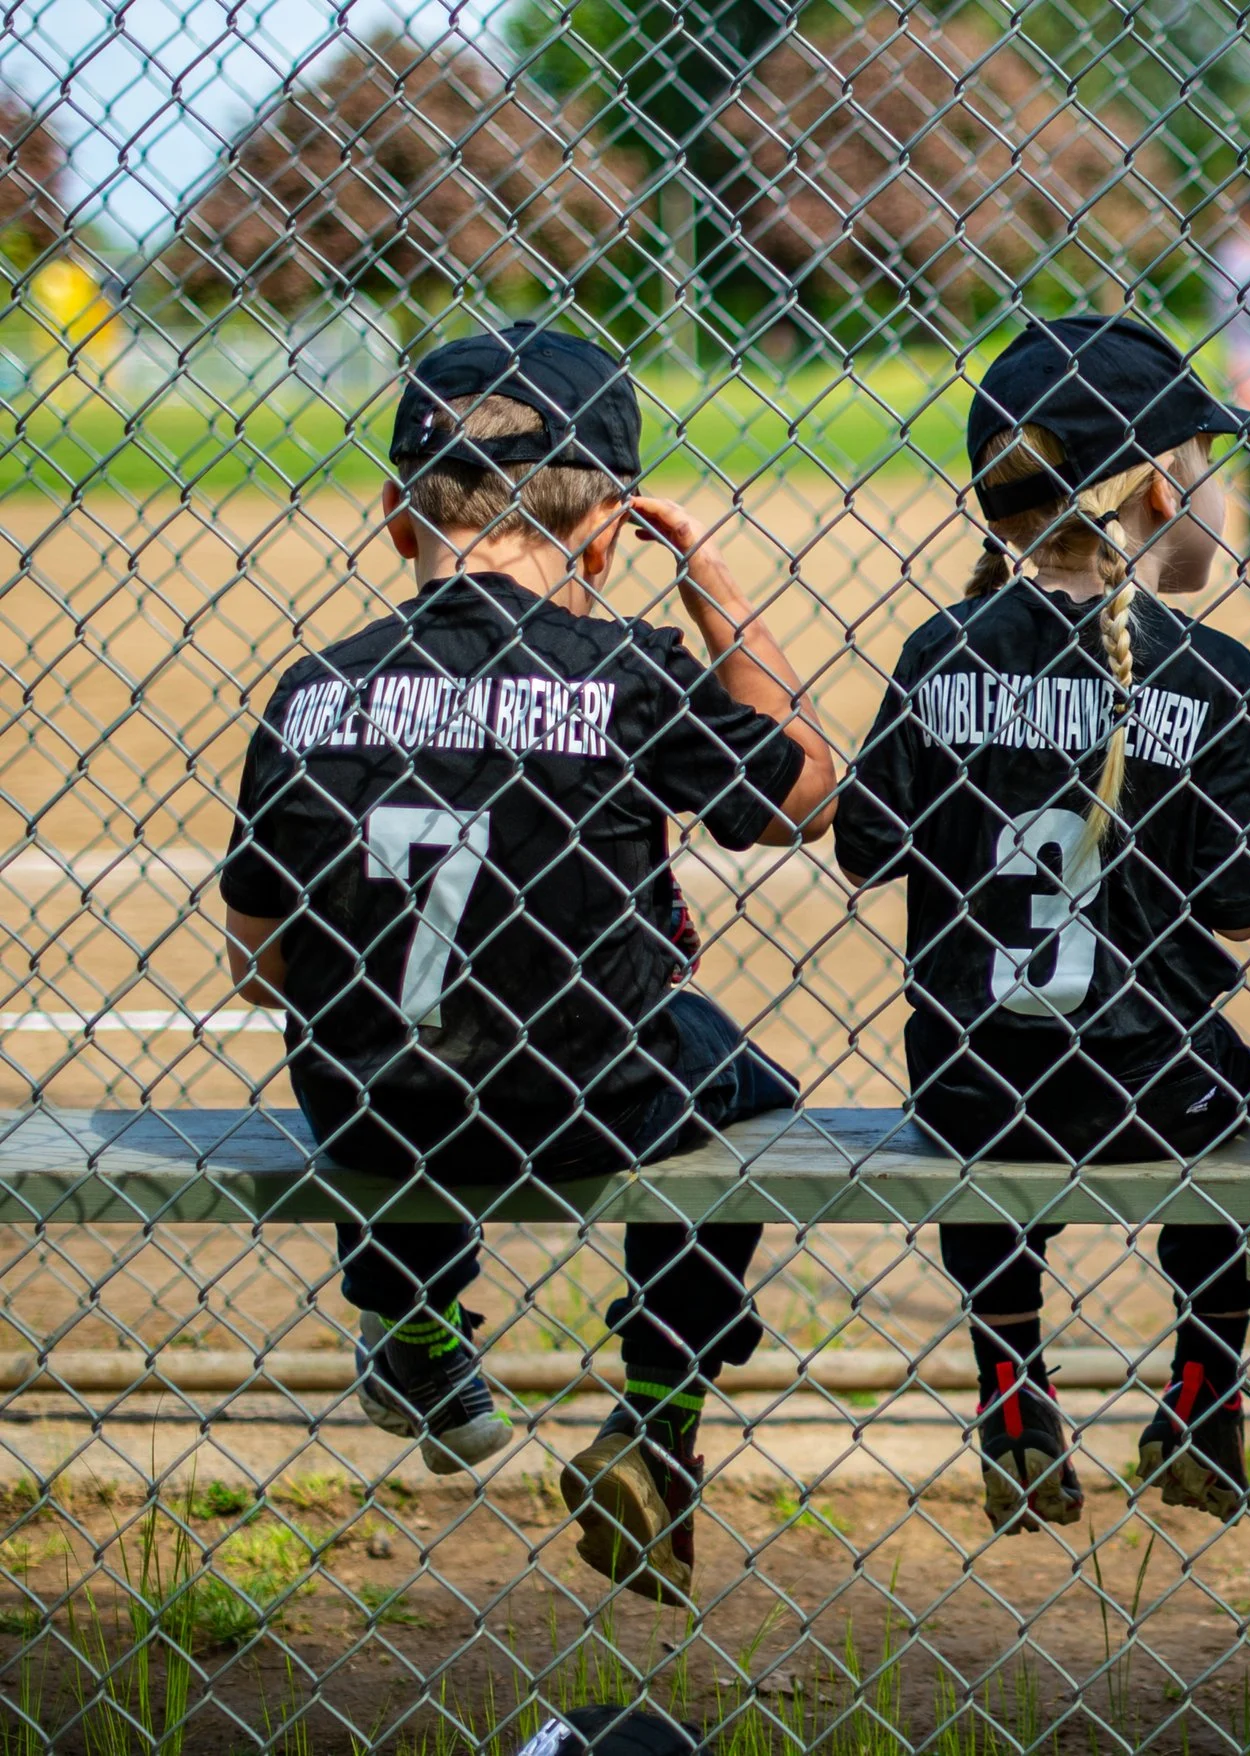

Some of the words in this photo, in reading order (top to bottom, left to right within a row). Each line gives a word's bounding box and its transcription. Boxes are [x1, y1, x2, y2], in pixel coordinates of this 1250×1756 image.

[281, 677, 368, 753] DOUBLE
[365, 676, 492, 749] MOUNTAIN
[495, 678, 615, 756] BREWERY
[918, 672, 997, 748] DOUBLE
[1097, 679, 1210, 769] BEWERY
[368, 806, 490, 1028] 7
[991, 808, 1101, 1017] 3
